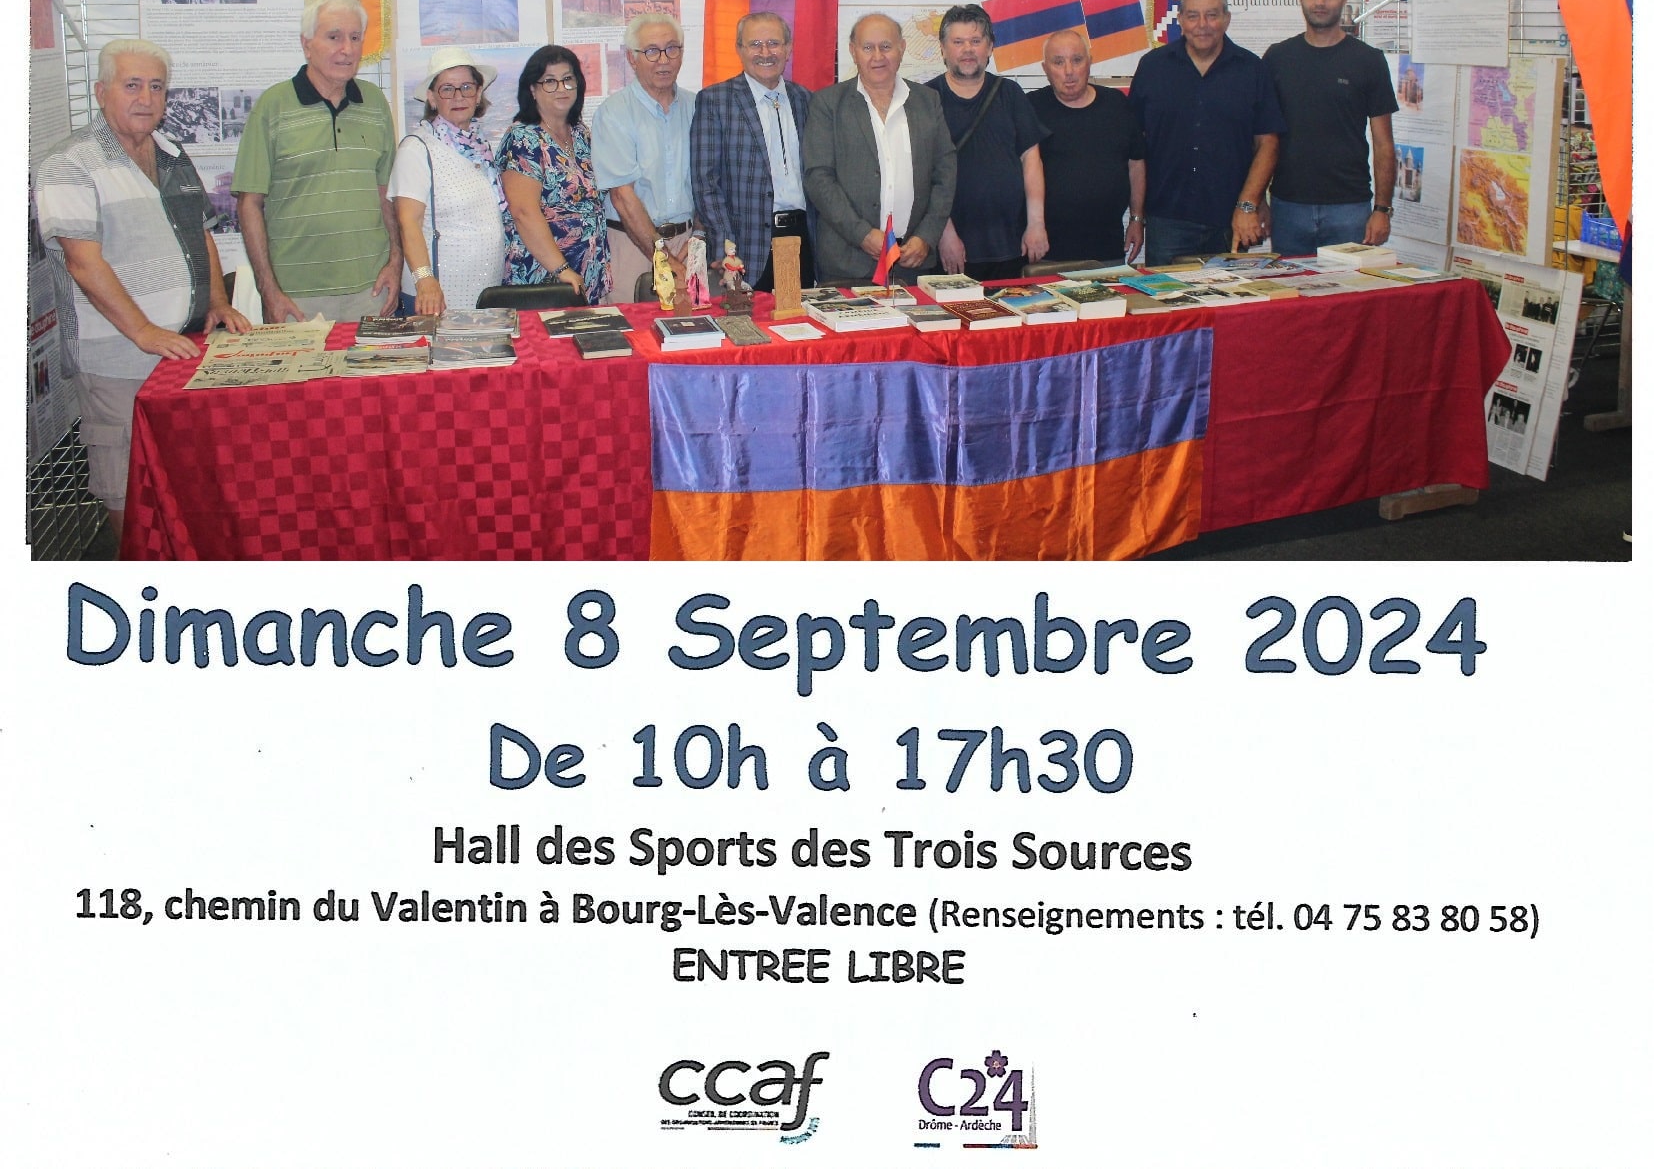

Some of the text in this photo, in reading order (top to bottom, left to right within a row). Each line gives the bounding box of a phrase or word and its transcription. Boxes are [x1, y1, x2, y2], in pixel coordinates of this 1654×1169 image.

[67, 582, 1487, 697] Dimanche 8 Septembre 2024
[490, 722, 1133, 793] De 10h à 17h30
[435, 824, 1192, 875] Hall des Sports des Trois Sources
[77, 888, 1539, 939] 118, chemin du Valentin à Bourg-Lès-Valence (Renseignements : tél. 04 75 83 80 58)
[673, 948, 965, 984] ENTREE LIBRE
[658, 1051, 830, 1131] ccaf
[918, 1057, 1029, 1131] C24
[919, 1119, 953, 1130] Drôme
[960, 1119, 1002, 1130] Ardèche
